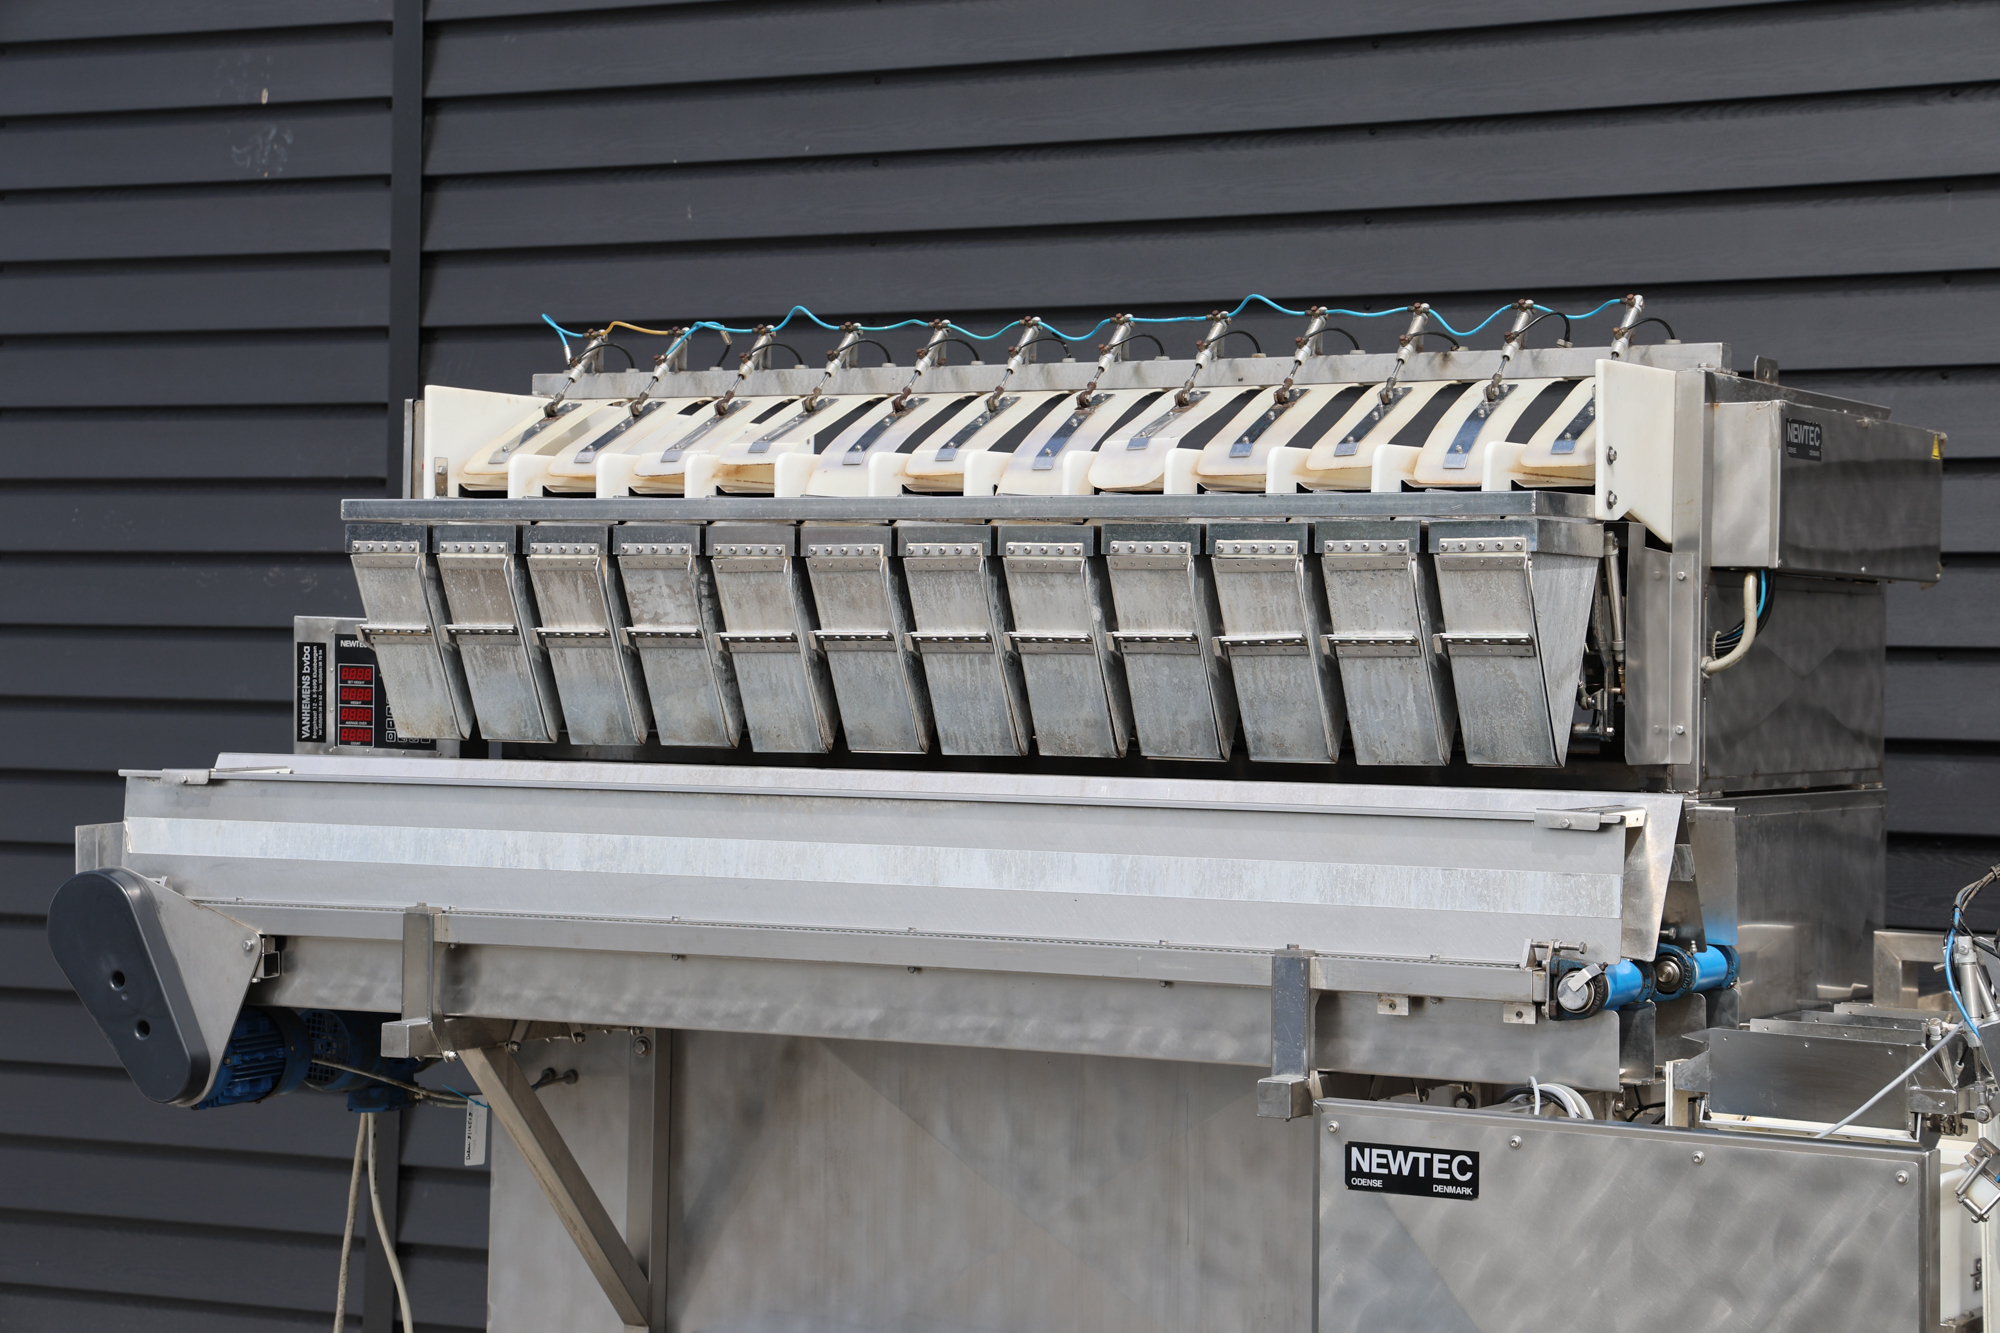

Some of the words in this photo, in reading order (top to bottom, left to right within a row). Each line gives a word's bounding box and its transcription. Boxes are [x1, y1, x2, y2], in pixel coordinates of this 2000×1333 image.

[1787, 423, 1820, 446] NEWTEC
[302, 646, 311, 674] bvba
[302, 675, 311, 739] VANHEMENS
[1351, 1146, 1473, 1182] NEWTEC
[1351, 1177, 1383, 1188] ODENSE
[1433, 1184, 1473, 1196] DENMARK
